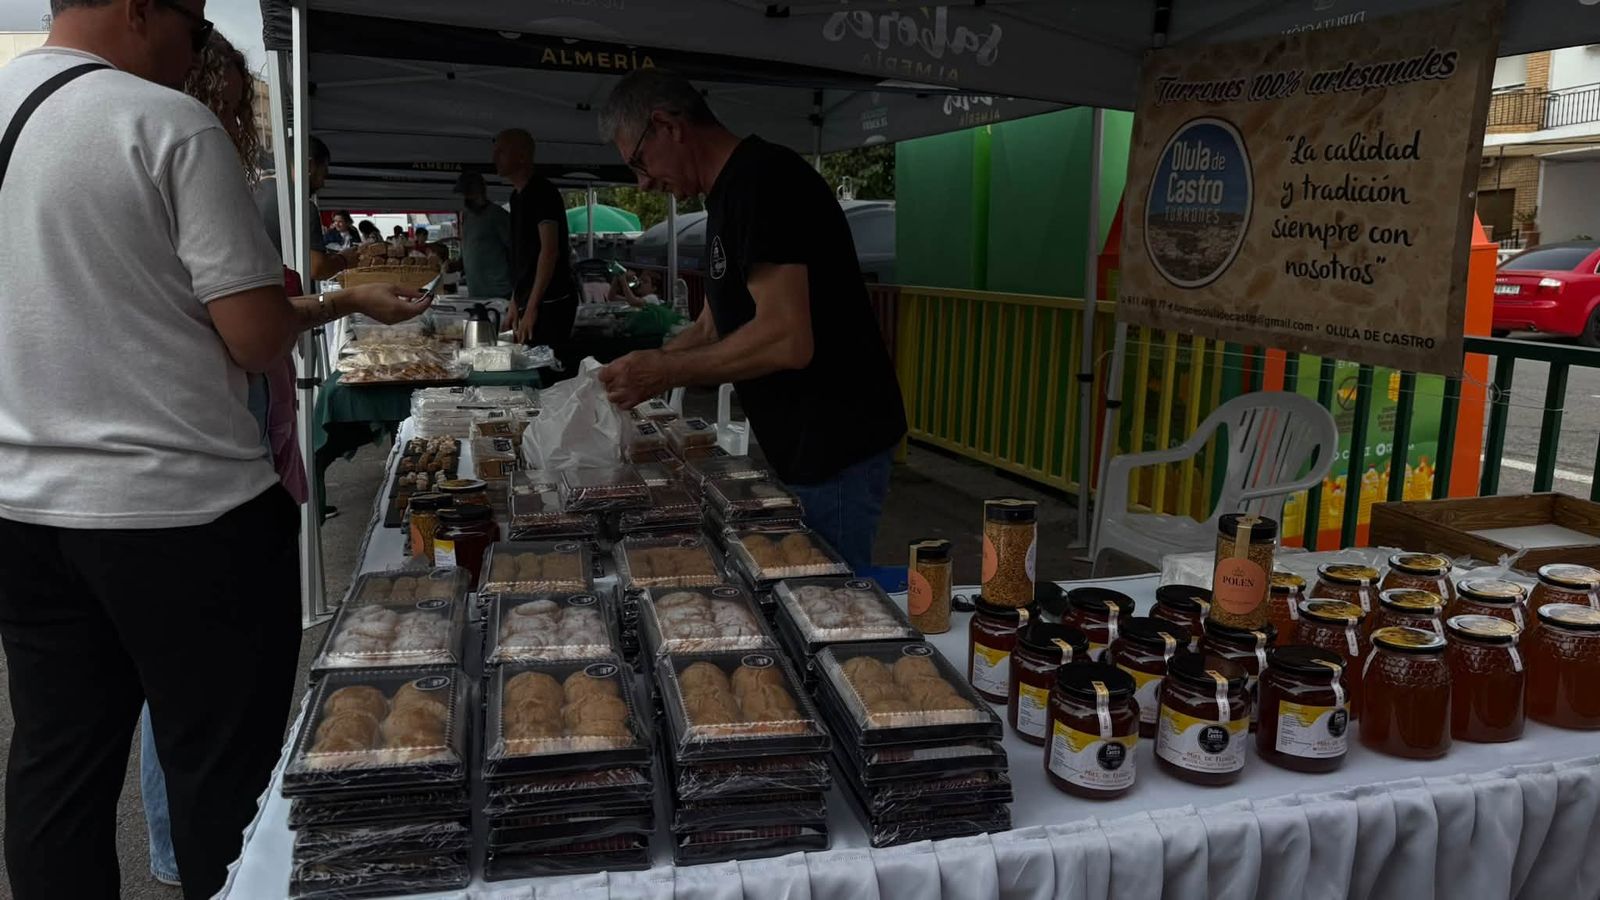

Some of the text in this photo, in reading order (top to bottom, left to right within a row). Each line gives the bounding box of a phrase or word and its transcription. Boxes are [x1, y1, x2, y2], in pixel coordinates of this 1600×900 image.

[540, 47, 656, 70] ALMERÍA
[1157, 48, 1458, 101] Turrones 100% artesanales
[1171, 140, 1226, 171] Olula de
[1324, 130, 1421, 162] calidad
[1166, 173, 1224, 205] Castro
[1280, 173, 1411, 209] y tradición
[1271, 215, 1413, 250] siempre con
[1326, 323, 1360, 340] OLULA
[1364, 329, 1380, 342] DE
[1383, 331, 1435, 349] CASTRO
[1222, 575, 1254, 587] POLEN
